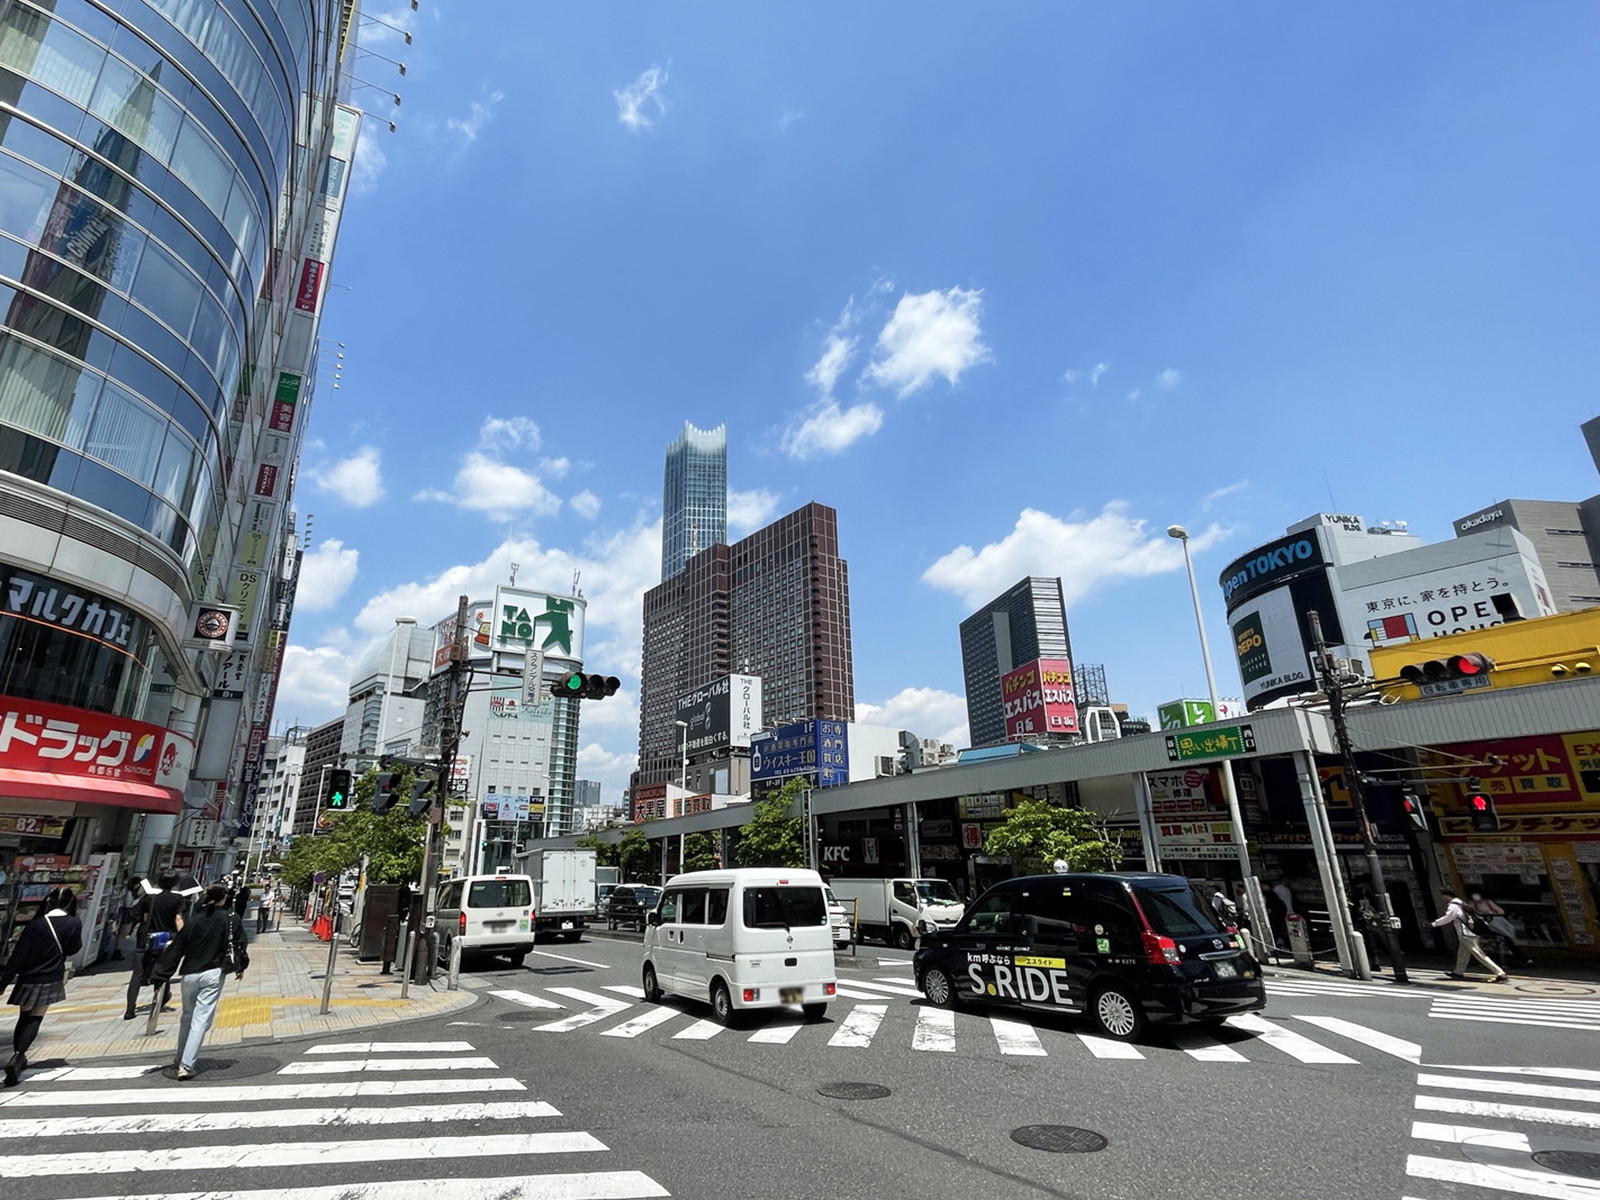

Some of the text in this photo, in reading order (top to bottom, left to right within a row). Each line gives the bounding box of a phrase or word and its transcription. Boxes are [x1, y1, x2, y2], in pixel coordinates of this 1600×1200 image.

[1325, 514, 1360, 524] YUNIKA
[1460, 509, 1503, 531] okadaya
[1246, 540, 1313, 579] TOKYO
[240, 573, 257, 584] DS
[1365, 577, 1510, 613] 東京に、家を持とう。
[1238, 634, 1262, 656] DEPO
[1005, 670, 1035, 695] パチンコ
[1043, 670, 1072, 685] パチンコ
[1260, 677, 1284, 690] YUNIKA
[677, 680, 730, 711] THEグローバル社
[1004, 690, 1043, 720] エスパス
[1044, 686, 1075, 703] エスパス
[0, 711, 132, 767] ドラッグ
[803, 723, 814, 734] 1F
[1180, 734, 1239, 756] 思い出横丁
[762, 749, 815, 771] ウイスキー王国
[1148, 774, 1183, 788] スマホ
[1446, 816, 1600, 832] ビクチケッ
[823, 846, 850, 862] KFC
[1025, 958, 1054, 966] エスライド
[967, 962, 1073, 1006] S.RIDE
